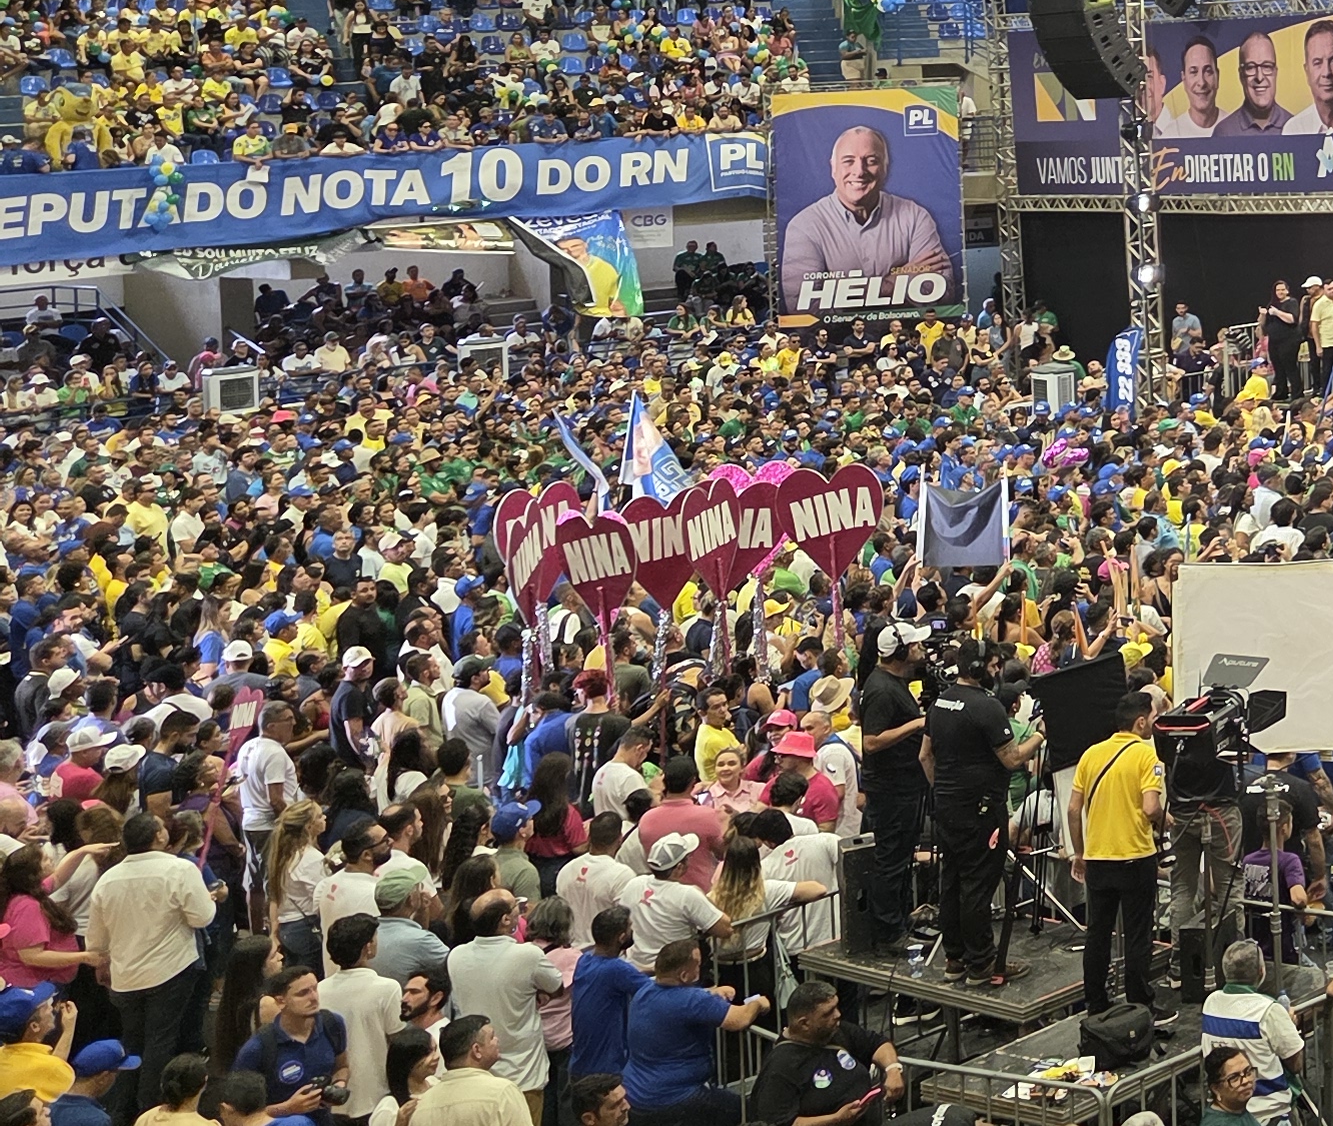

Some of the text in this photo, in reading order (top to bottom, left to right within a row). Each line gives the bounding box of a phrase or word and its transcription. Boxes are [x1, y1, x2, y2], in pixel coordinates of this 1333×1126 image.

[909, 109, 934, 126] PL
[720, 142, 765, 171] PL
[1036, 156, 1088, 186] VAMOS
[1257, 152, 1269, 182] O
[1272, 152, 1295, 182] RN
[280, 169, 431, 217] NOTA
[440, 147, 524, 203] 10
[536, 155, 612, 196] DO
[619, 148, 689, 188] RN
[631, 213, 668, 228] CBG
[194, 247, 226, 259] SOU
[803, 270, 846, 280] CORONEL
[890, 265, 932, 275] SENADOR
[796, 269, 947, 311] HÉLIO
[823, 315, 831, 324] O
[866, 313, 878, 321] de
[1118, 375, 1133, 404] 22
[788, 486, 877, 541] NINA
[629, 513, 685, 564] NIN
[687, 500, 737, 562] NINA
[512, 523, 543, 592] NINA
[562, 531, 632, 586] NINA
